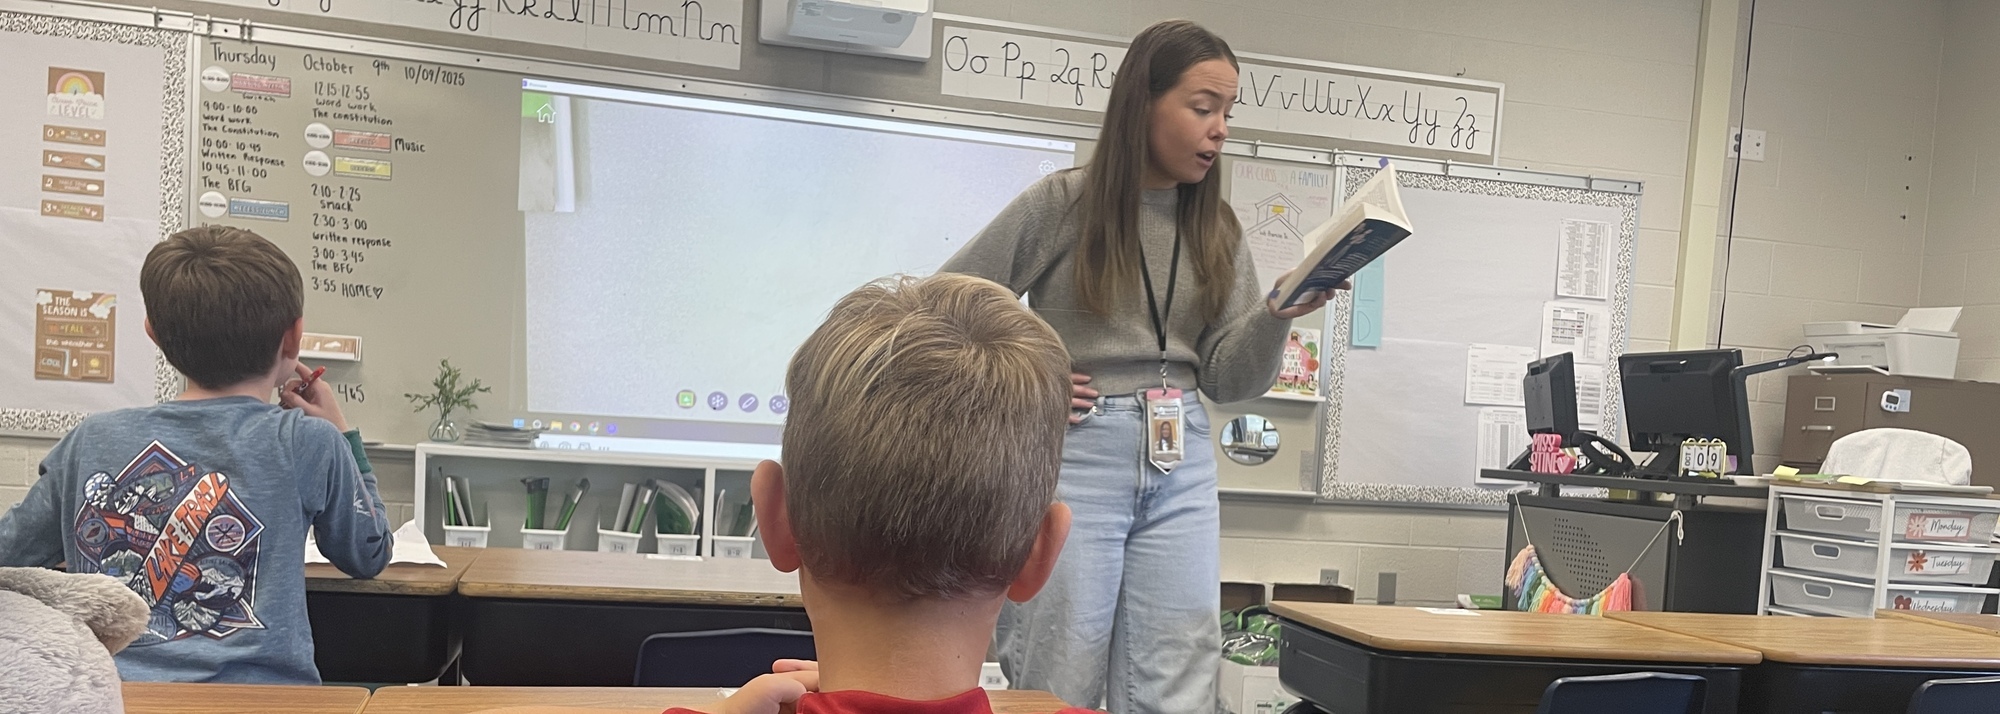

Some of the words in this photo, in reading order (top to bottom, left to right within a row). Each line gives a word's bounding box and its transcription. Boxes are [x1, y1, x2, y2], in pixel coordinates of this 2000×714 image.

[210, 41, 276, 72] Thursday
[303, 53, 354, 75] October
[372, 59, 391, 76] 9th
[404, 64, 466, 87] 10/09/2025
[944, 35, 990, 74] Oo
[1001, 41, 1037, 100] Pp
[1249, 71, 1299, 110] Vv
[1301, 77, 1353, 117] Ww
[1354, 84, 1396, 123] Xx
[1402, 89, 1442, 146] Yy
[312, 107, 329, 119] The
[202, 123, 218, 132] The
[221, 124, 280, 139] Constitution
[394, 137, 426, 153] Music
[201, 148, 237, 160] Written
[243, 152, 286, 167] Response
[201, 175, 221, 189] The
[227, 177, 252, 193] BFG
[1255, 166, 1277, 183] CLASS
[1298, 170, 1328, 189] FAMILY!
[351, 236, 392, 249] response
[311, 259, 328, 271] The
[333, 261, 354, 275] BFG
[311, 276, 337, 293] 3:55
[55, 296, 72, 307] THE
[42, 305, 78, 317] SEASON
[80, 307, 88, 318] IS
[1532, 433, 1557, 453] MISS
[145, 522, 191, 602] LAKE
[173, 471, 229, 537] TRAIL
[1930, 519, 1964, 538] Monday
[1930, 555, 1965, 574] Tuesday
